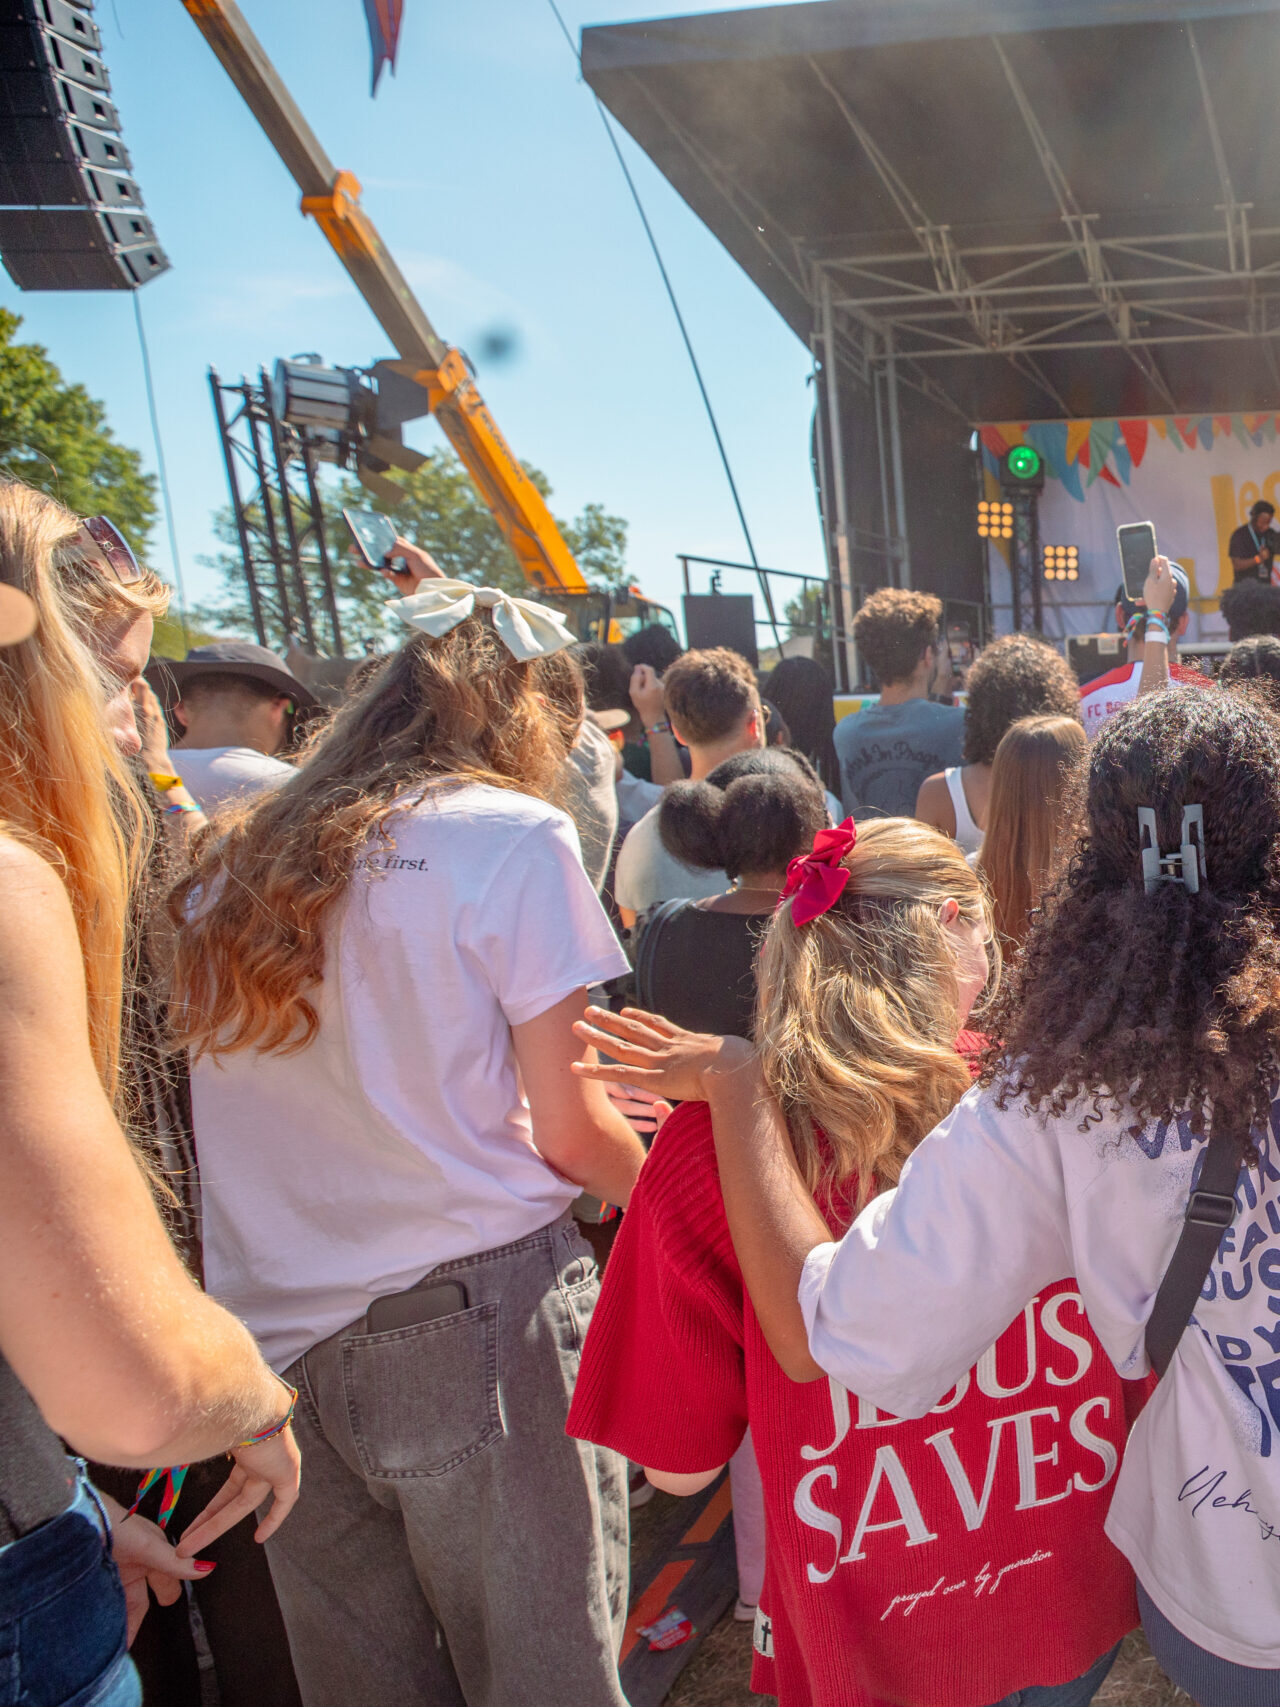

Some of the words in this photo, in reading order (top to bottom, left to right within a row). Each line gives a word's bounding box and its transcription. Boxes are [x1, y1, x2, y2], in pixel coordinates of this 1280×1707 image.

[1087, 703, 1102, 718] FC
[384, 854, 429, 872] first.
[793, 1396, 1118, 1584] SAVES
[880, 1576, 945, 1621] prayed
[943, 1580, 966, 1595] over
[974, 1561, 991, 1597] by
[989, 1550, 1052, 1595] generation
